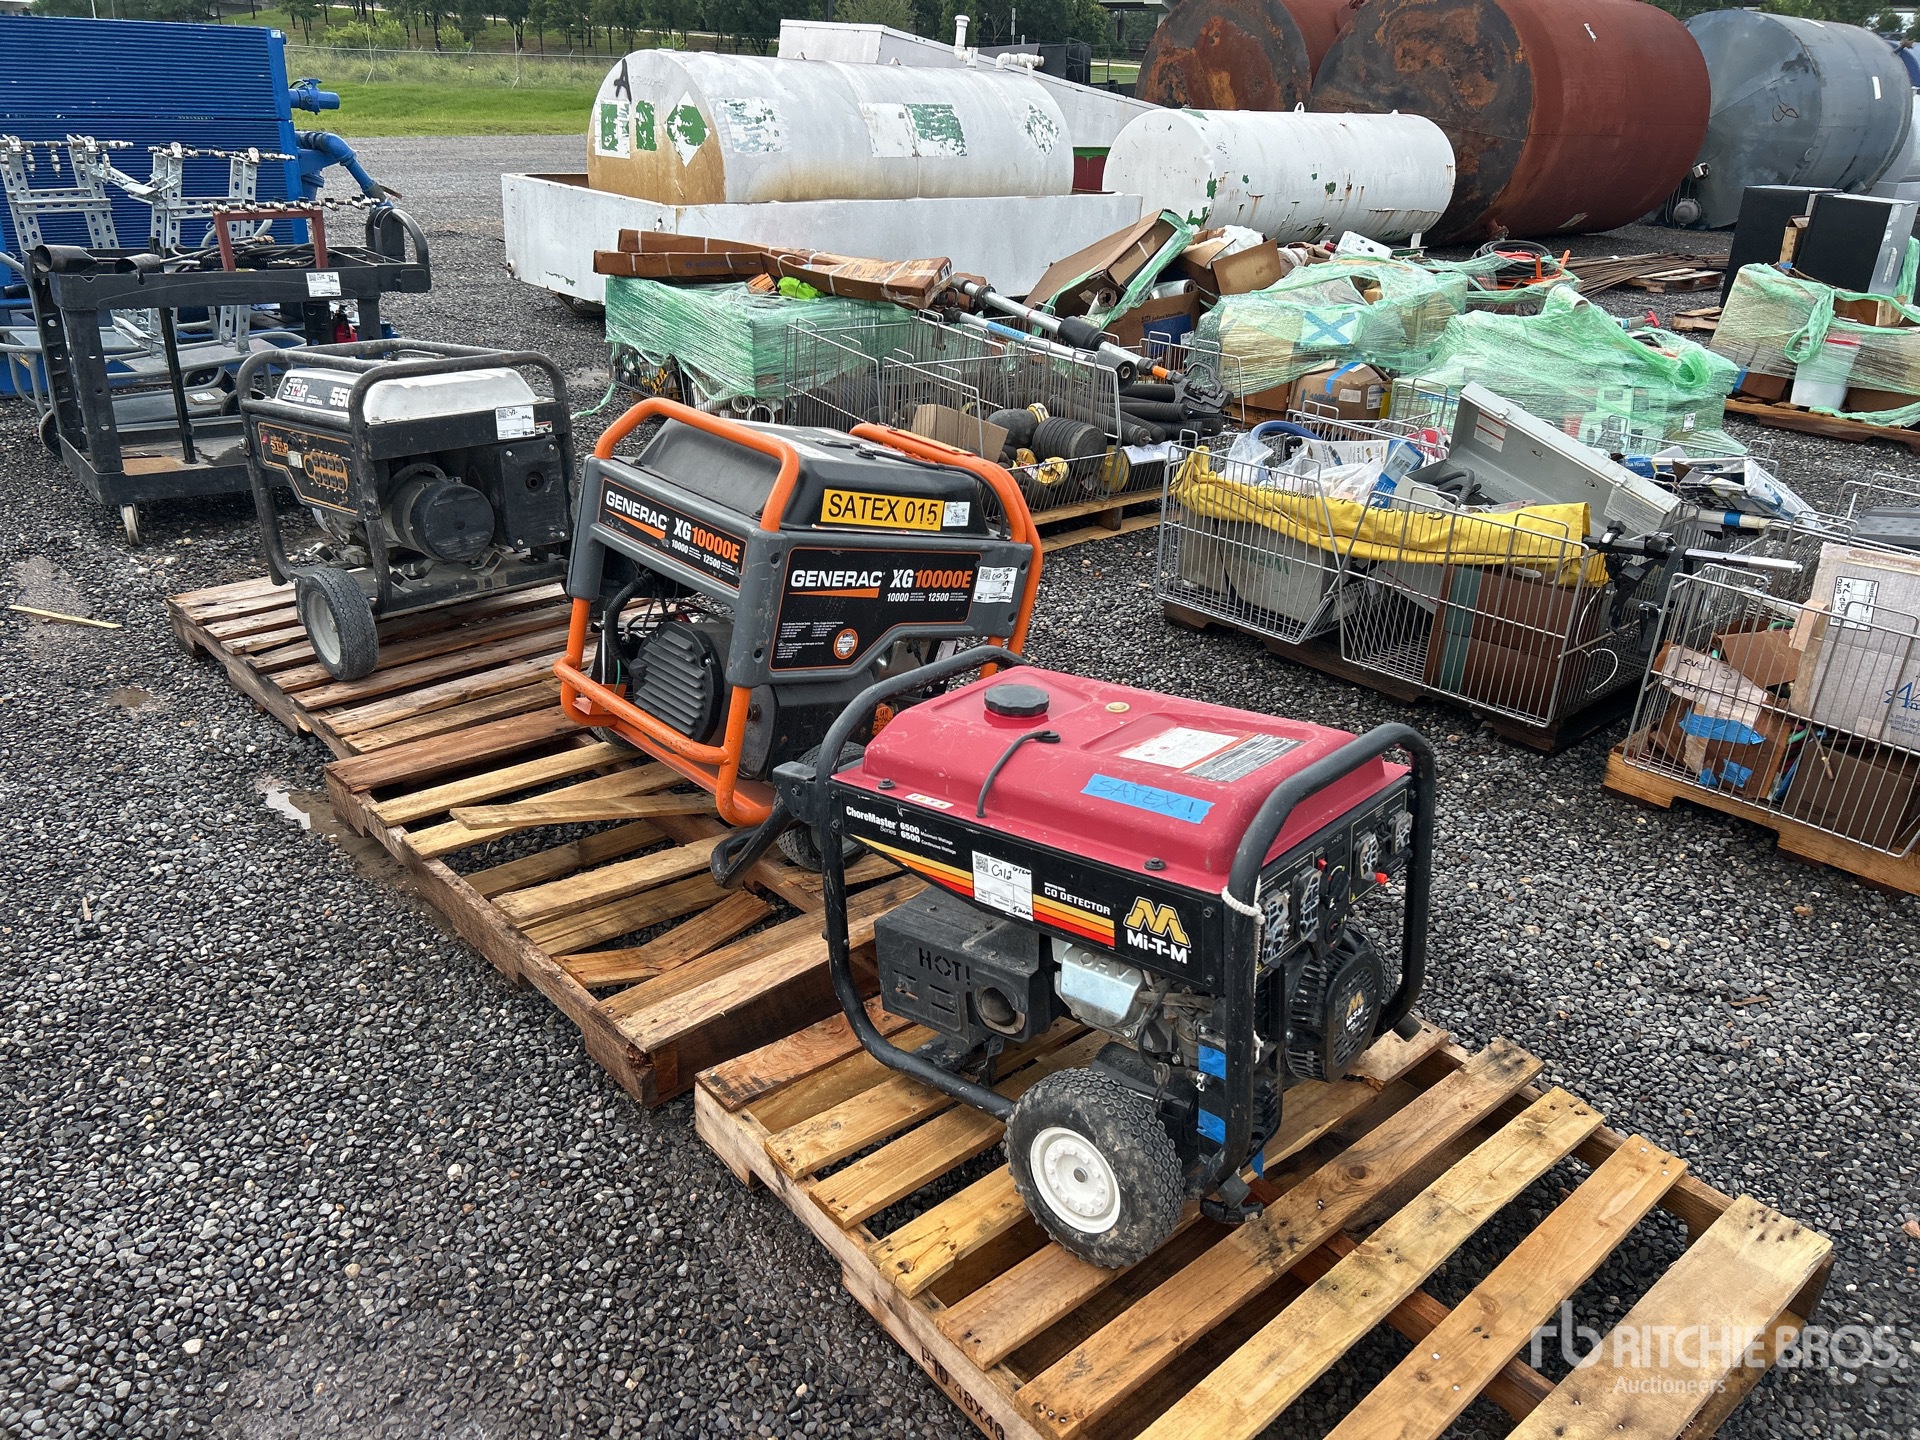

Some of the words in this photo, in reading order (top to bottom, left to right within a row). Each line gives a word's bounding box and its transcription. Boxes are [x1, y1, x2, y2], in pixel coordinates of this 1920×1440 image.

[284, 383, 309, 398] STAR
[329, 387, 351, 408] 55
[828, 493, 900, 522] SATEX
[904, 501, 938, 525] 015
[605, 490, 667, 531] GENERAC
[673, 517, 740, 563] XG10000E
[702, 554, 721, 570] 12500
[791, 569, 883, 587] GENERAC
[889, 568, 974, 589] XG10000E
[887, 592, 910, 602] 10000
[928, 592, 950, 602] 12500
[846, 806, 897, 830] ChoreMaster
[900, 822, 920, 835] 6500
[879, 825, 897, 836] Series
[900, 830, 921, 844] 6500
[1044, 886, 1058, 898] CO
[1060, 890, 1111, 916] DETECTOR
[1126, 929, 1188, 964] Mi-T-M
[919, 947, 971, 986] HOT!
